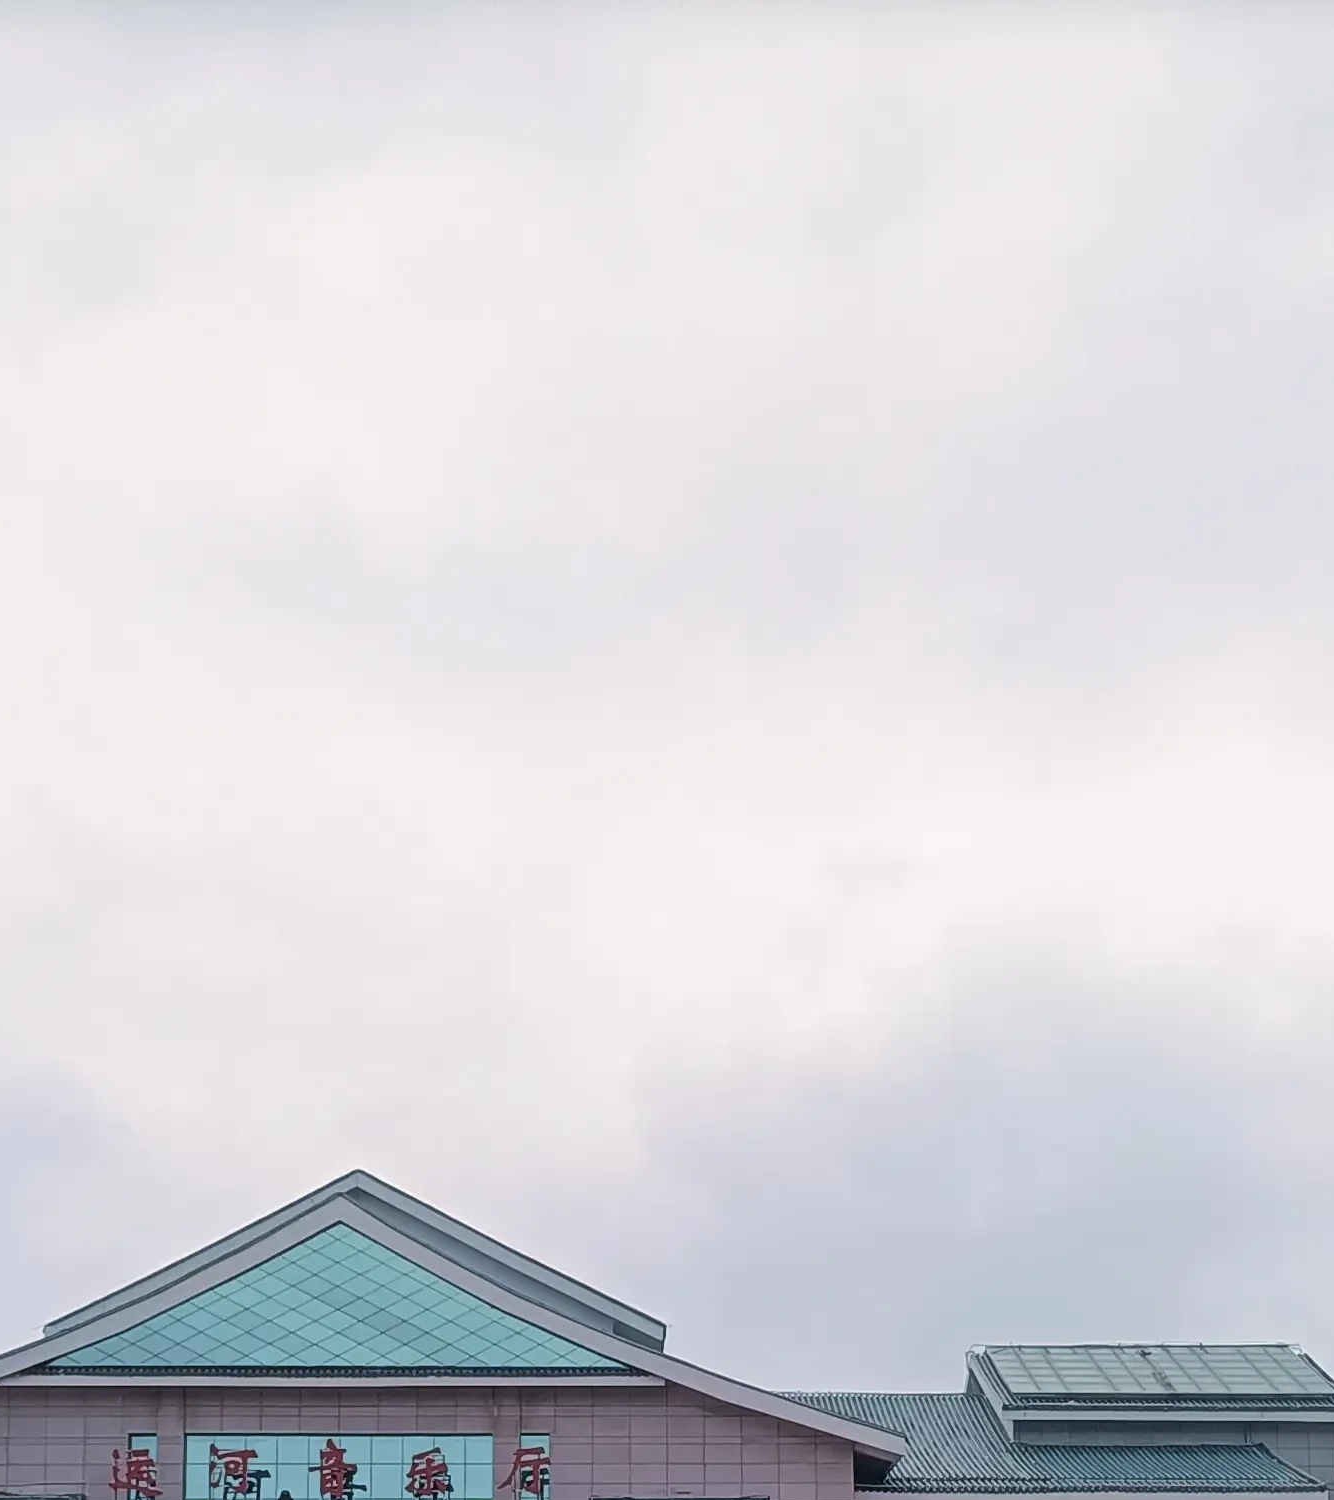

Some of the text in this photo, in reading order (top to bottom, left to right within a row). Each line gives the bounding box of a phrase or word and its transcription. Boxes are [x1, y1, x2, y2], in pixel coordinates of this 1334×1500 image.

[108, 1439, 552, 1496] 运河音乐厅
